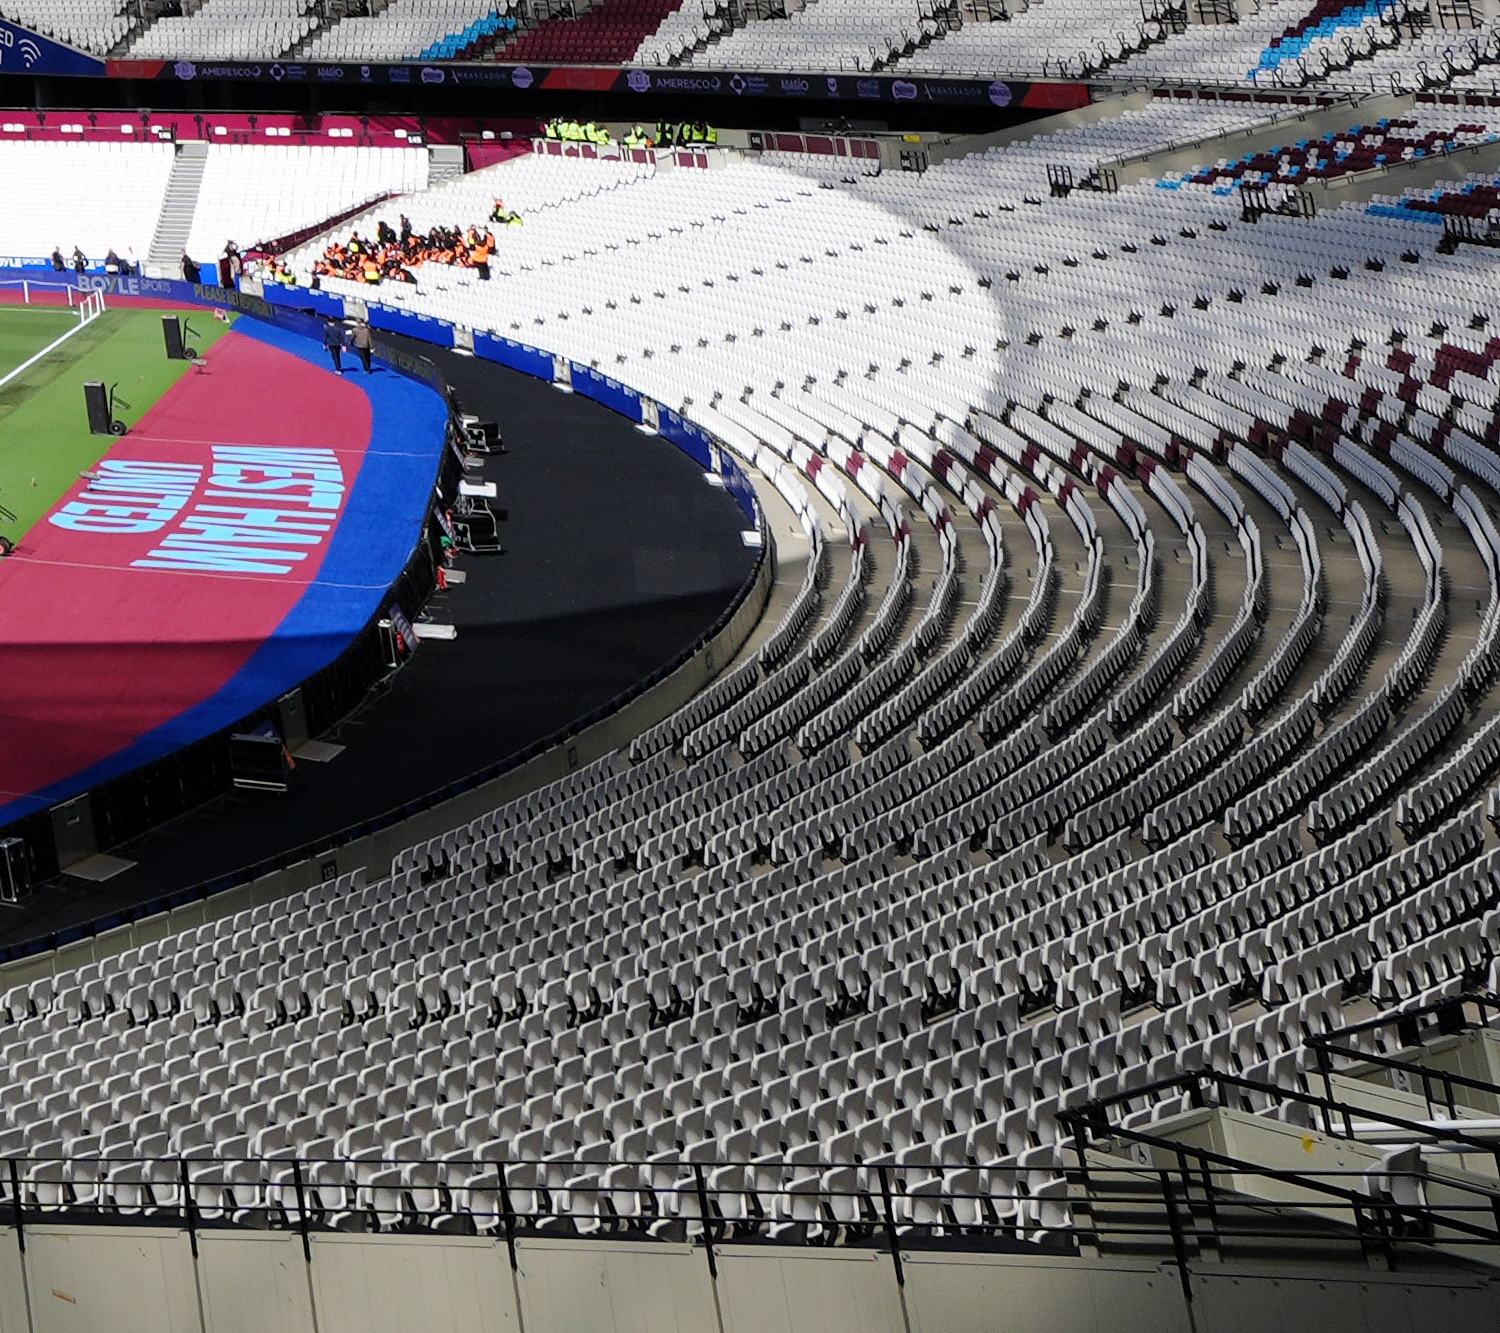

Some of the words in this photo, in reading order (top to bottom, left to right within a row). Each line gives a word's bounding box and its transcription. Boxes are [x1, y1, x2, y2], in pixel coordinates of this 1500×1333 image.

[201, 68, 252, 77] AMERESCO
[656, 77, 710, 90] AMERESCO
[22, 257, 46, 266] SPORTS
[77, 275, 140, 296] BOYLE
[140, 278, 172, 294] SPORTS
[206, 445, 346, 510] WEST
[48, 459, 204, 534] UNITED
[129, 504, 337, 575] HAM
